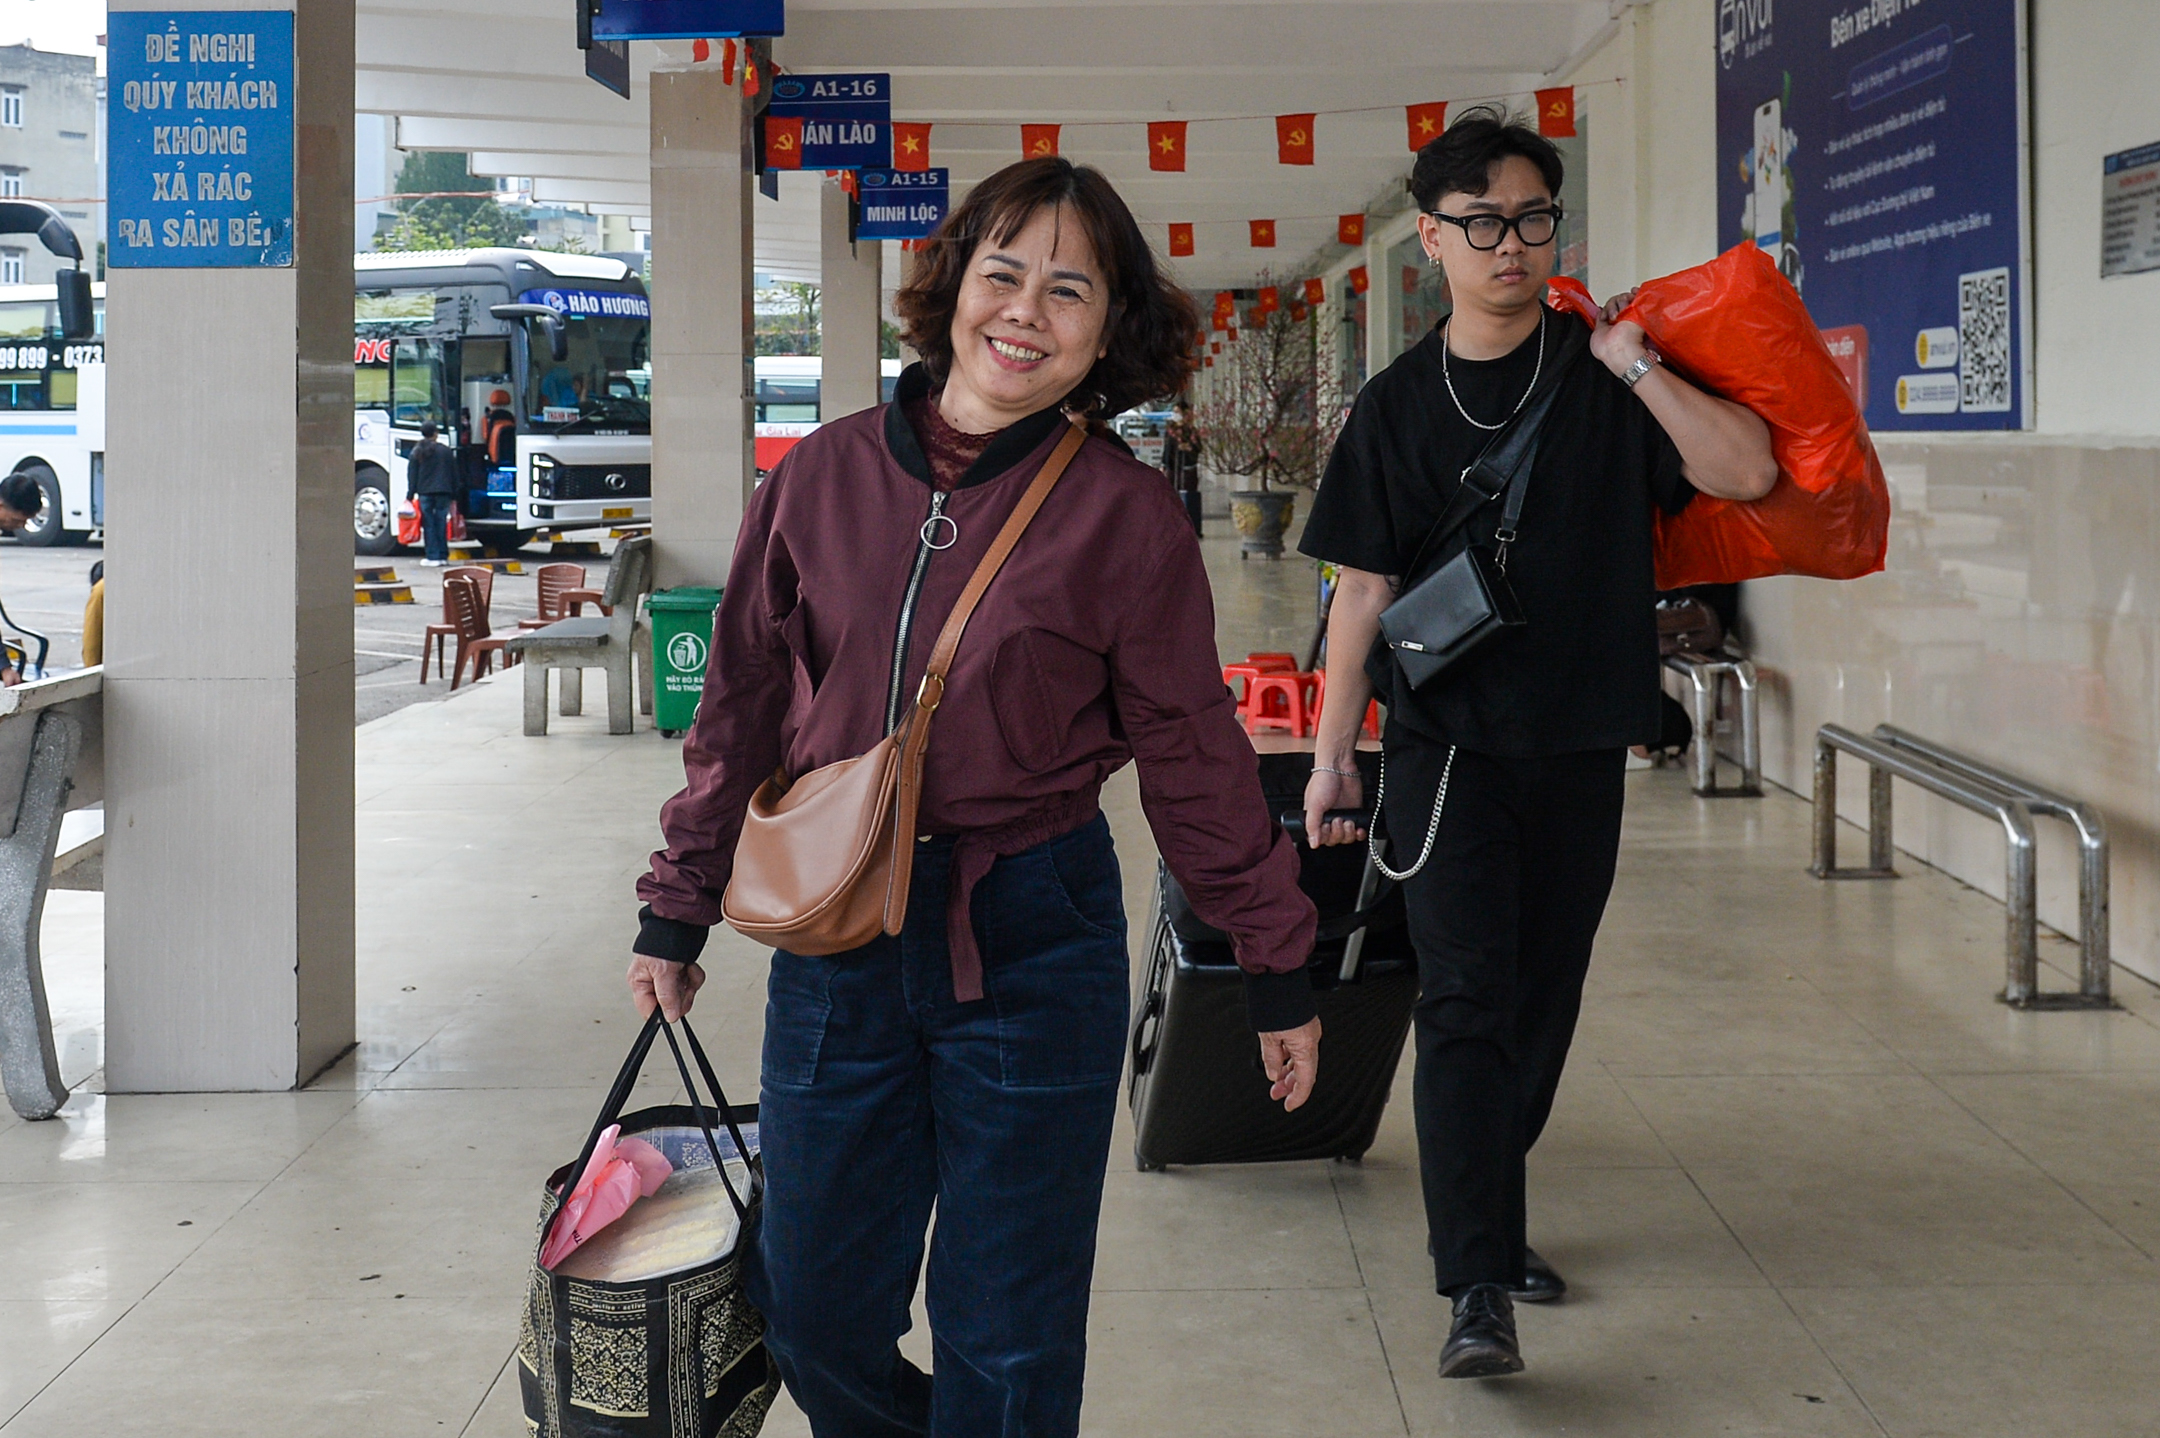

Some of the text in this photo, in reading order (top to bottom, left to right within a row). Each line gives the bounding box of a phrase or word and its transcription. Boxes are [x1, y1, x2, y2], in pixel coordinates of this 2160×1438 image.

[1831, 8, 1854, 48] Bến
[1855, 7, 1870, 36] xe
[145, 20, 255, 69] ĐỀ NGHỊ
[124, 72, 277, 113] QÚY KHÁCH
[812, 80, 877, 97] A1-16
[154, 117, 247, 155] KHÔNG
[801, 120, 876, 145] ÁN LÀO
[152, 160, 252, 201] XẢ RÁC
[891, 172, 938, 186] A1-15
[118, 218, 154, 247] RA
[162, 209, 219, 247] SÂN
[867, 202, 938, 225] MINH LỘC
[568, 291, 649, 316] HÀO HƯƠNG
[18, 346, 48, 369] 899
[63, 345, 103, 369] 0373
